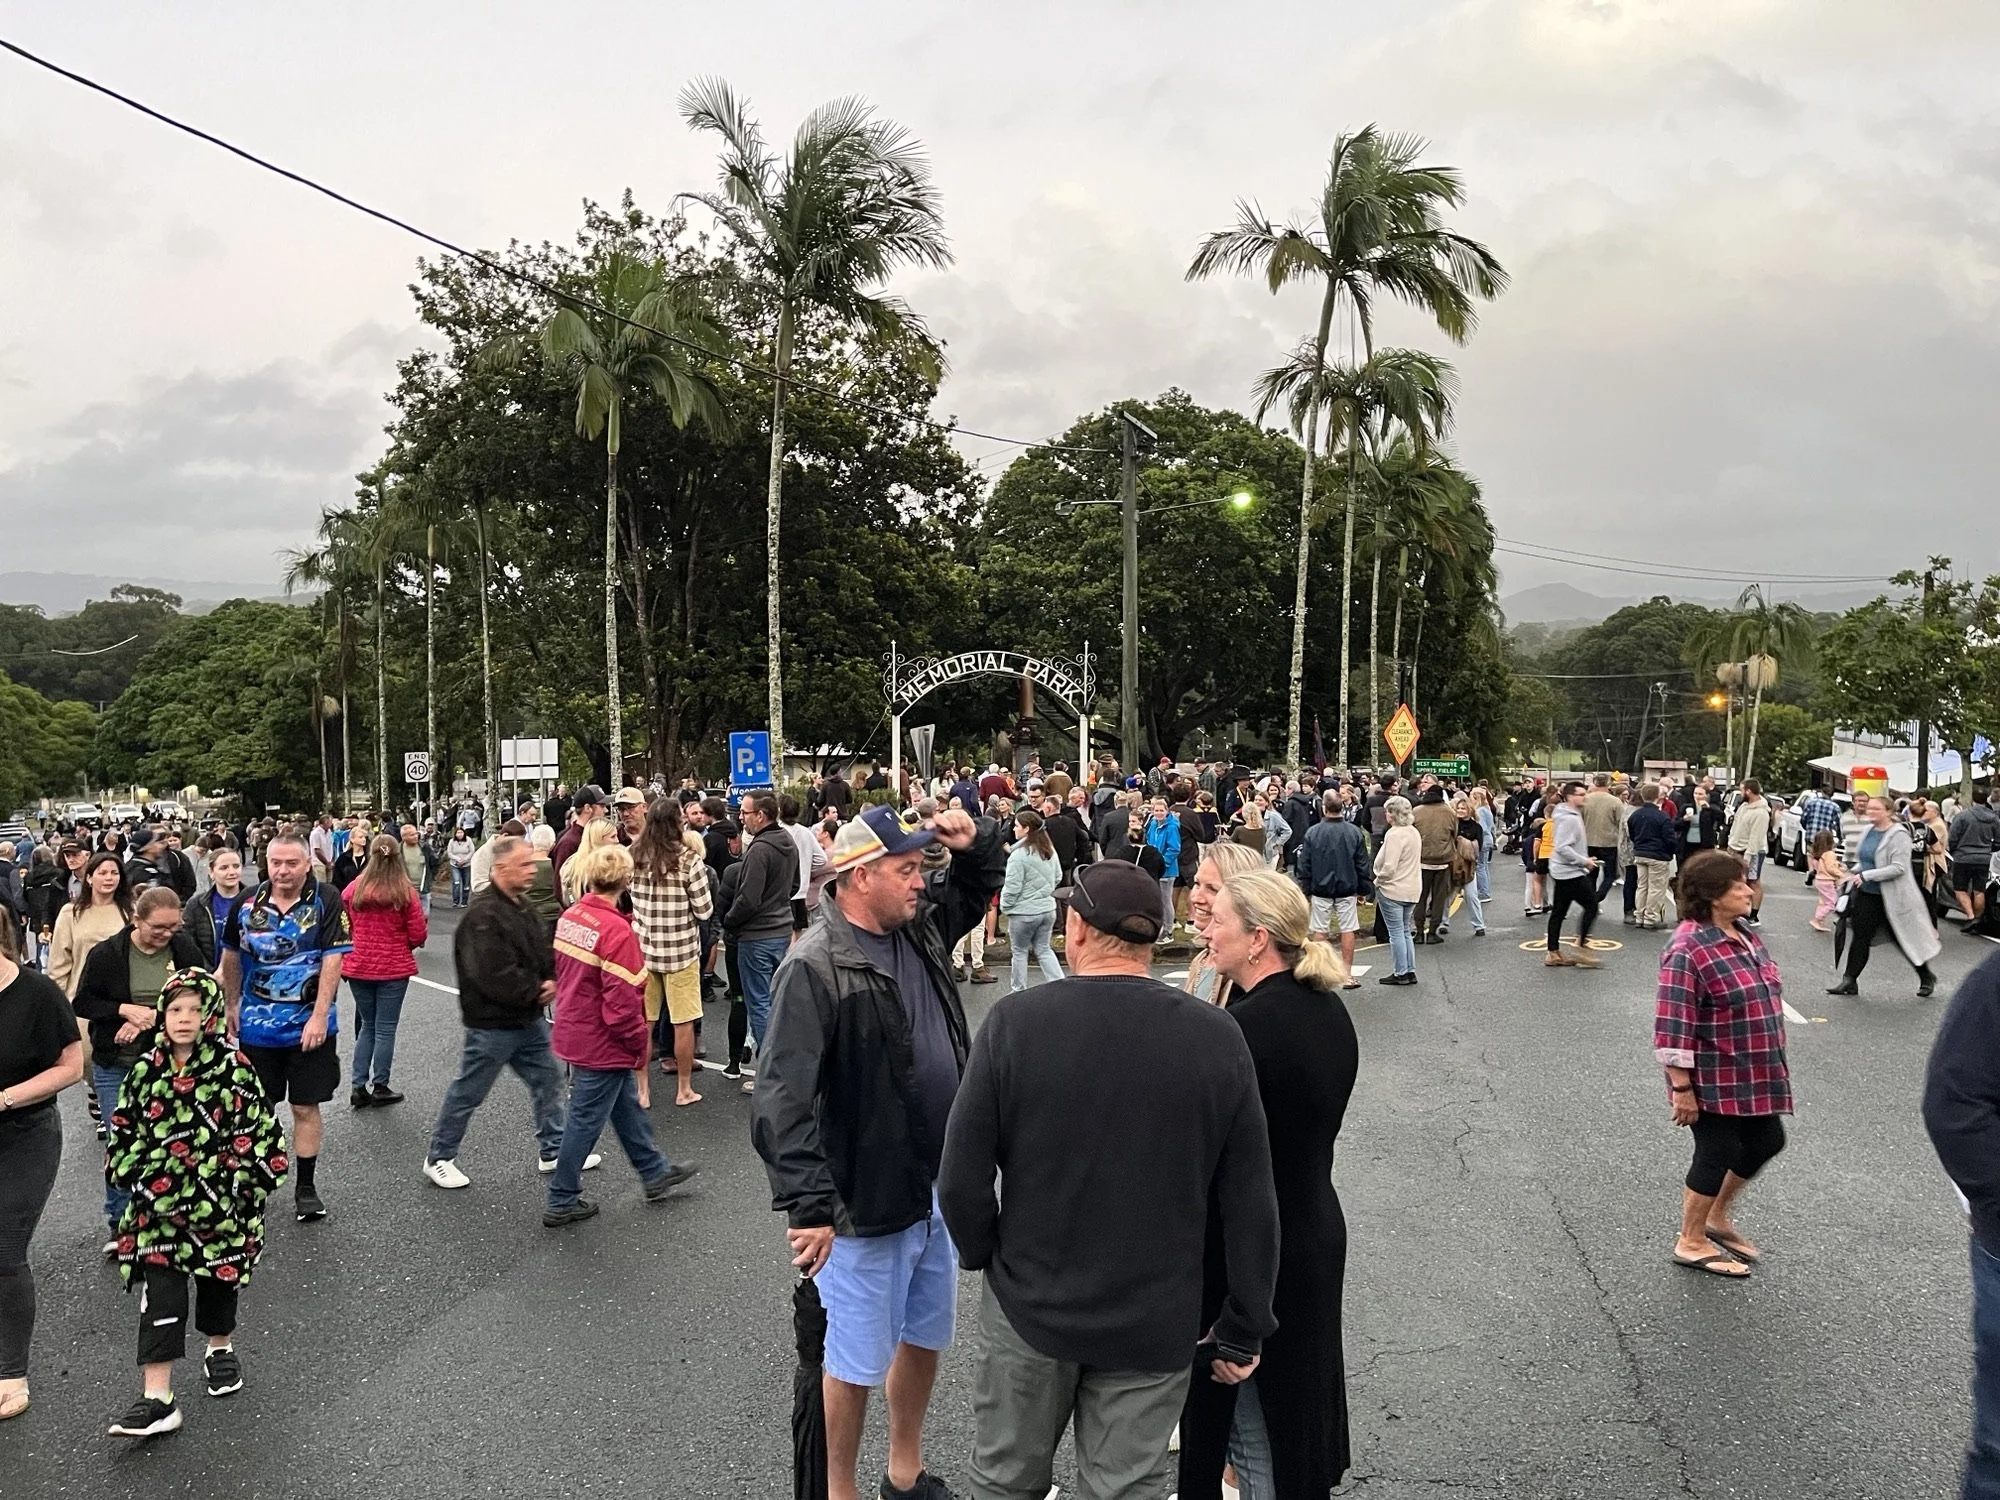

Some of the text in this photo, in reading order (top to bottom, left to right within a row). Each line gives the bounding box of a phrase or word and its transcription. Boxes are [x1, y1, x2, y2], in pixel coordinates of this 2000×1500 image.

[899, 653, 1081, 705] MEMORIAL PARK
[410, 766, 425, 775] 40
[206, 1252, 246, 1267] MINECRAFT
